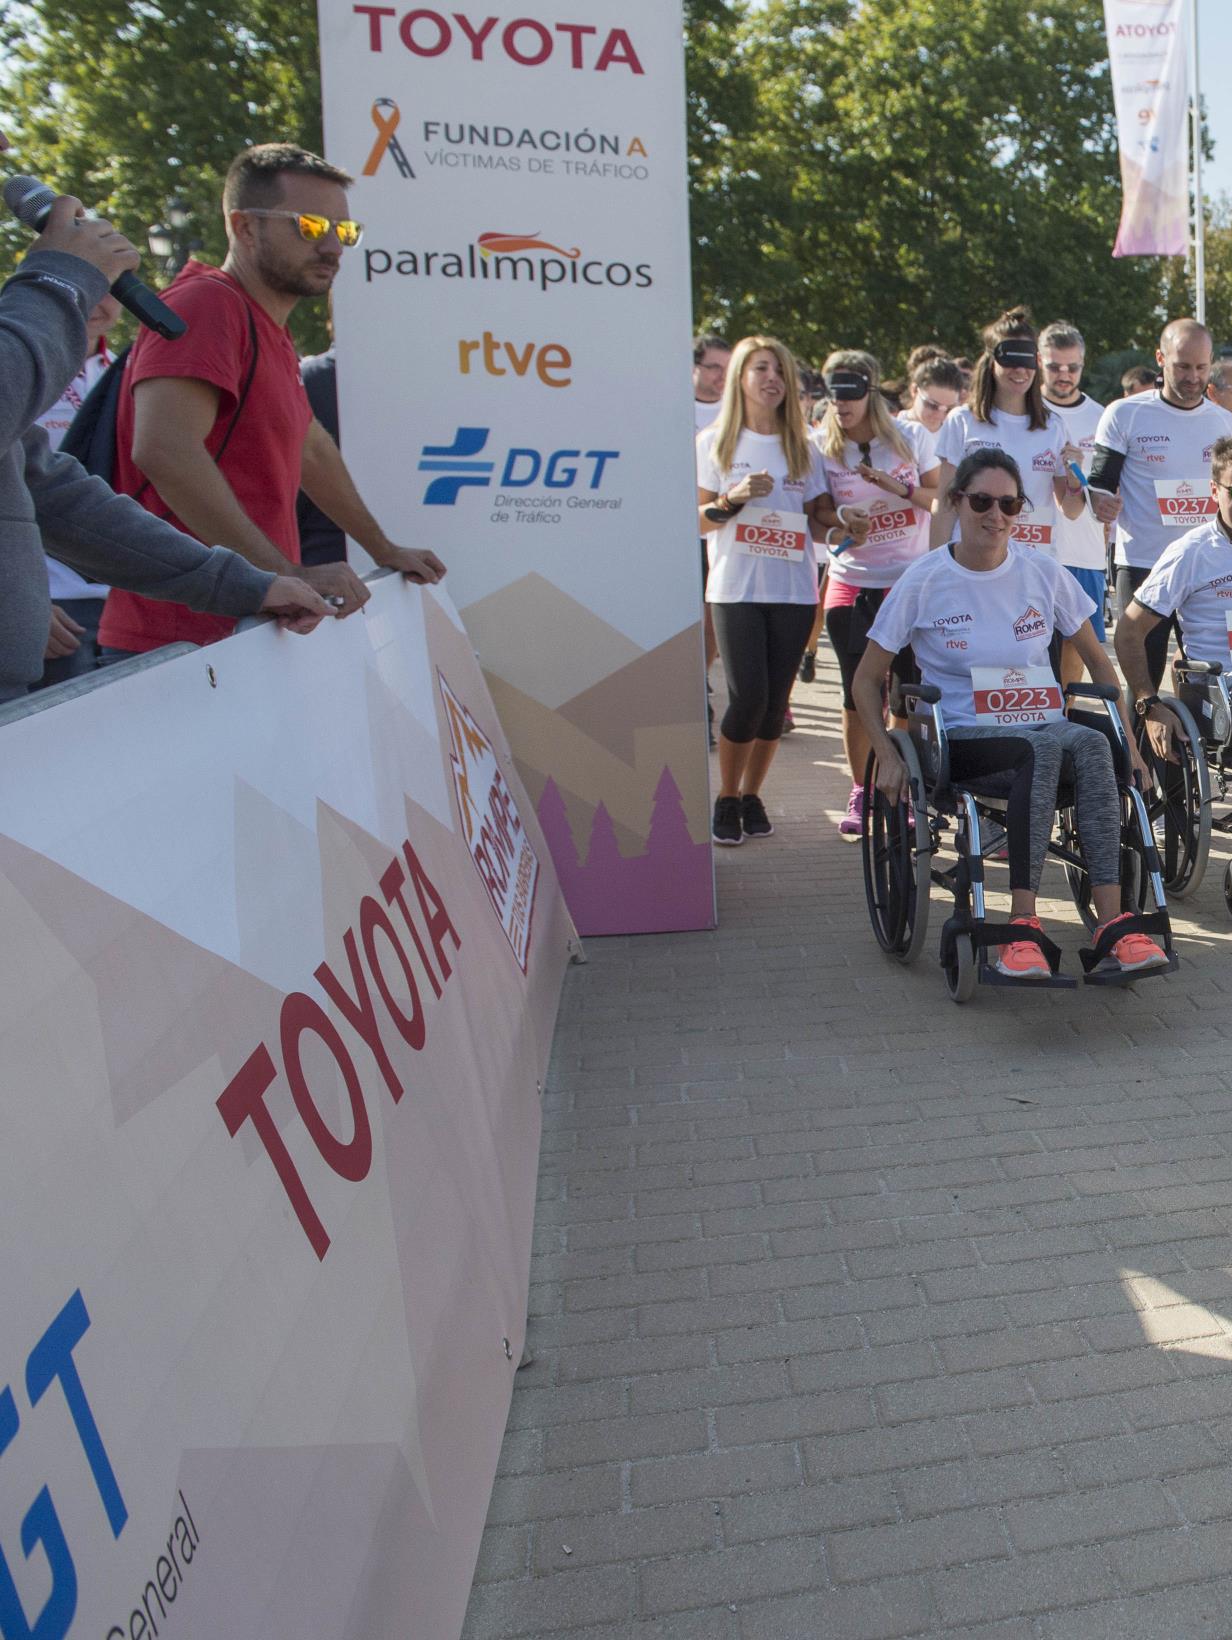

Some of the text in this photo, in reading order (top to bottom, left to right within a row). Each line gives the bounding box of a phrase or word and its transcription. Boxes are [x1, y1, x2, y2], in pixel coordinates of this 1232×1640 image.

[353, 4, 645, 75] TOYOTA
[423, 120, 648, 158] FUNDACIÓN A
[425, 149, 649, 180] VÍCTIMAS DE TRÁFICO
[458, 331, 572, 388] rtve
[1146, 454, 1166, 462] rtve
[500, 448, 620, 489] DGT
[494, 494, 623, 510] Dirección General
[1167, 498, 1209, 514] 0237
[490, 511, 561, 524] de Tráfico
[868, 511, 908, 533] 199
[1174, 516, 1208, 524] TOYOTA
[744, 526, 796, 548] 0238
[868, 529, 907, 543] TOYOTA
[1008, 524, 1042, 542] 235
[749, 545, 789, 557] TOYOTA
[932, 614, 973, 628] TOYOTA
[1015, 619, 1046, 635] ROMPE
[946, 639, 968, 650] rtve
[986, 688, 1050, 712] 0223
[995, 712, 1046, 724] TOYOTA
[474, 768, 521, 921] ROMPE
[215, 839, 462, 1263] TOYOTA
[105, 1489, 200, 1640] eneral
